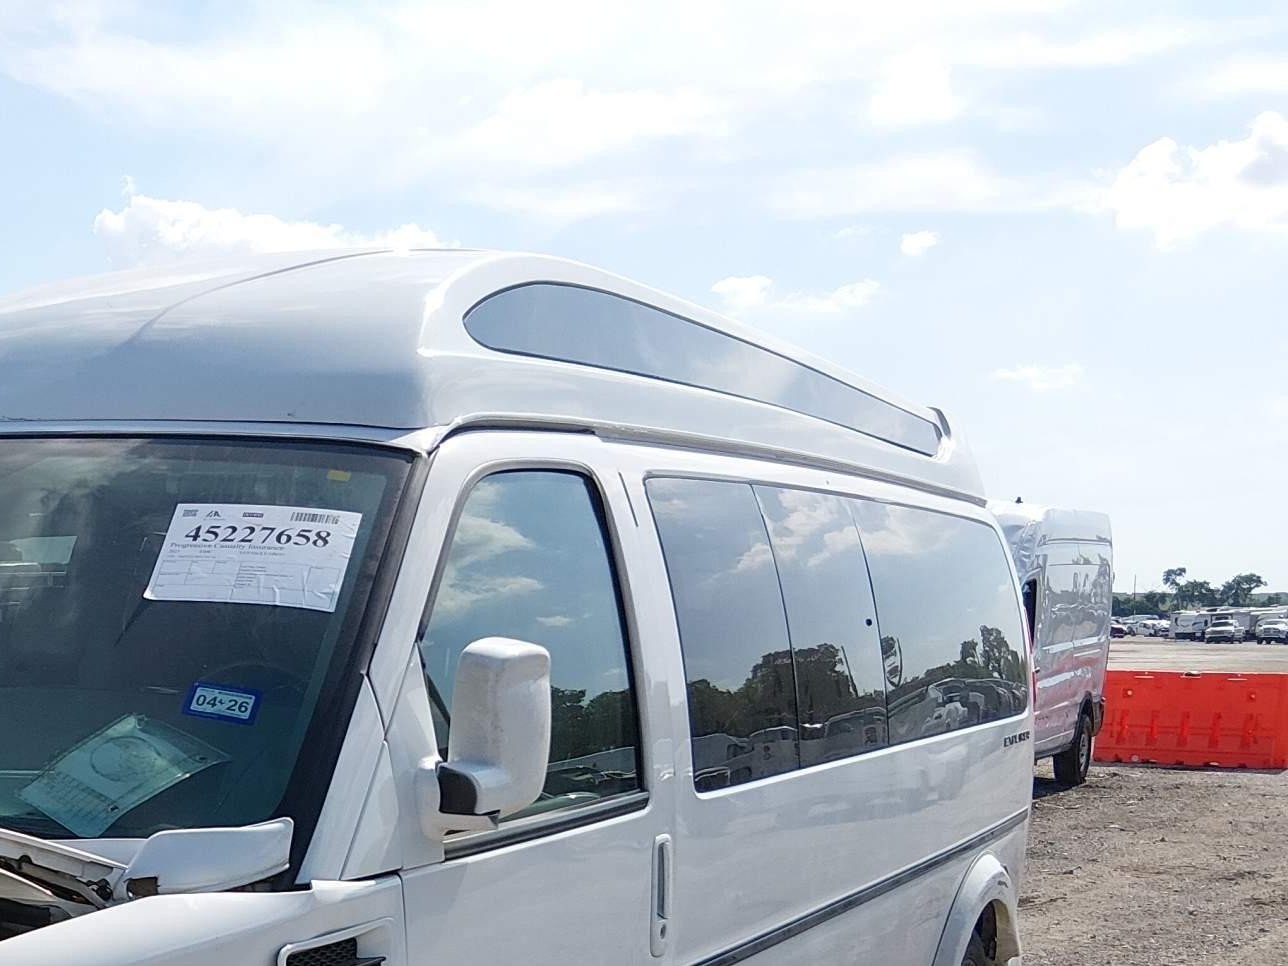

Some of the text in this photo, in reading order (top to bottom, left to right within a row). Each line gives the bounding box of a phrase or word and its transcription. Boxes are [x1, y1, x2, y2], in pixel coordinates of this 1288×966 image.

[185, 524, 332, 548] 45227658
[196, 694, 218, 708] 04
[226, 699, 250, 714] 26
